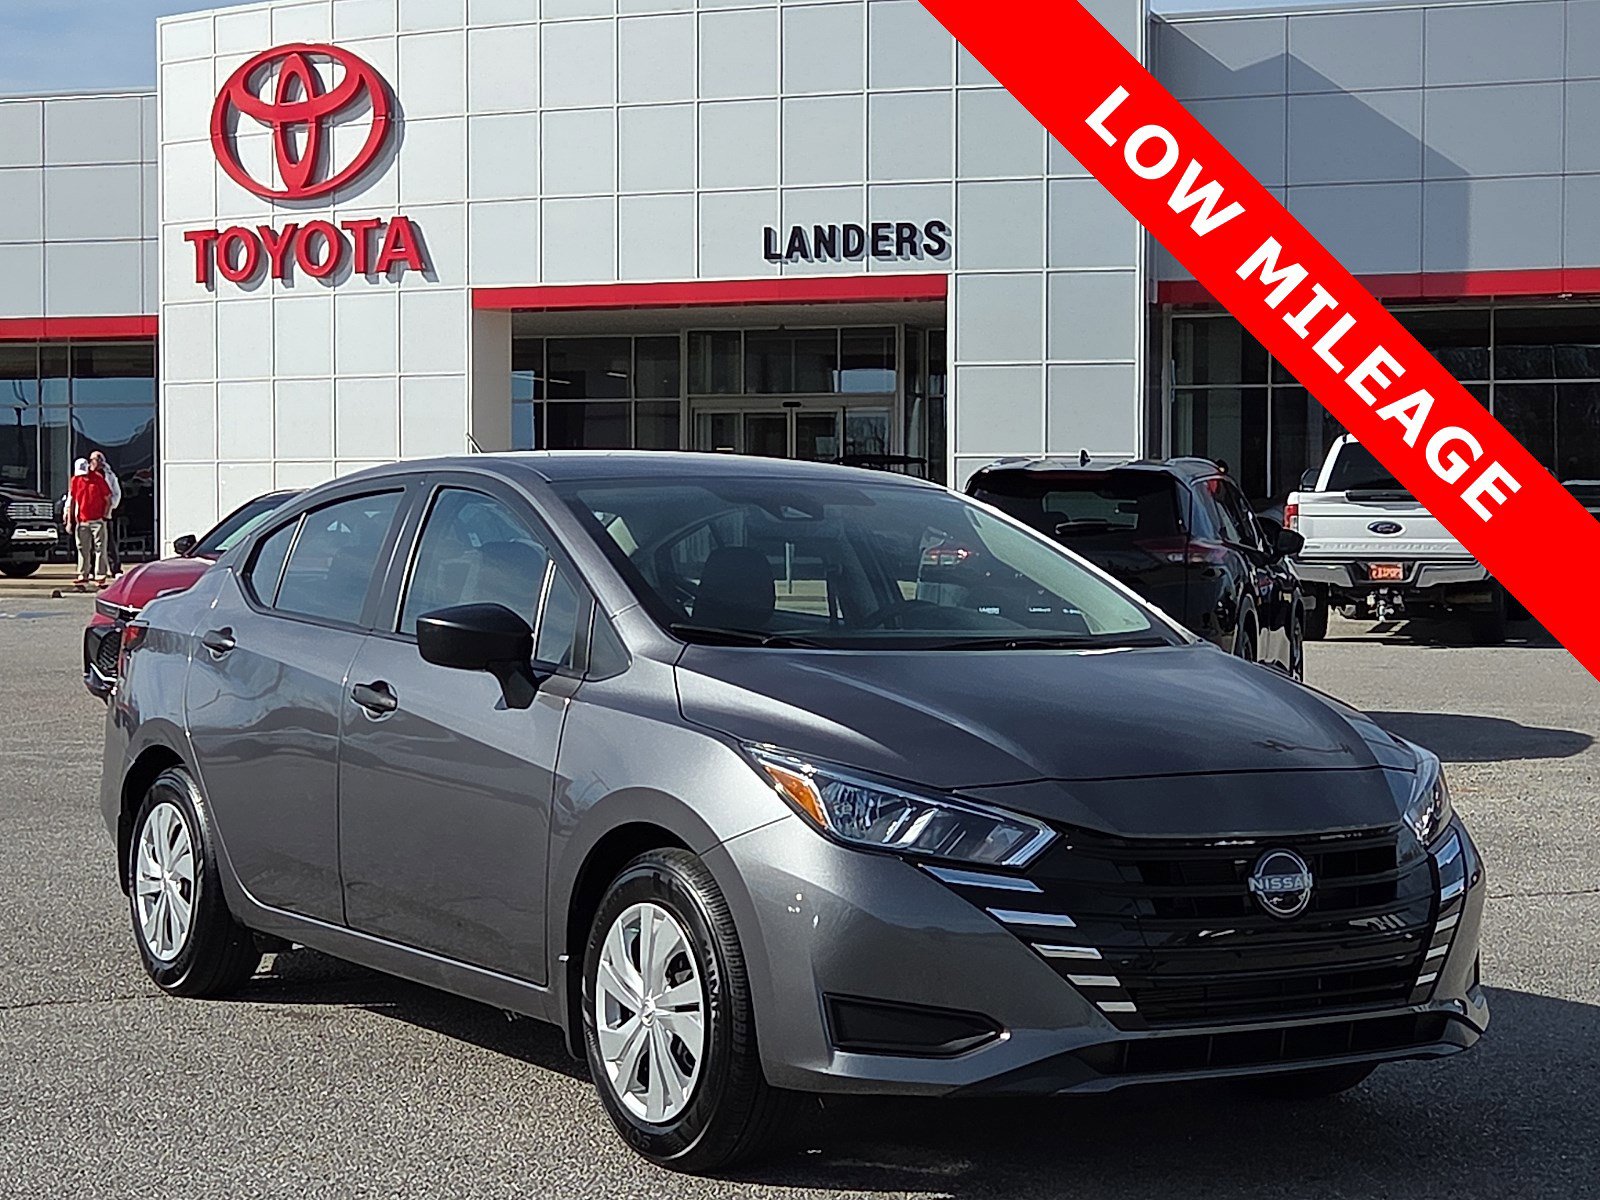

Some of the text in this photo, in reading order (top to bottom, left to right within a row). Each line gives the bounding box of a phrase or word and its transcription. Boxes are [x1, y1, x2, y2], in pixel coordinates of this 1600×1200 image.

[184, 216, 423, 283] TOYOTA
[763, 220, 947, 260] LANDERS
[1248, 873, 1313, 892] NISSAN
